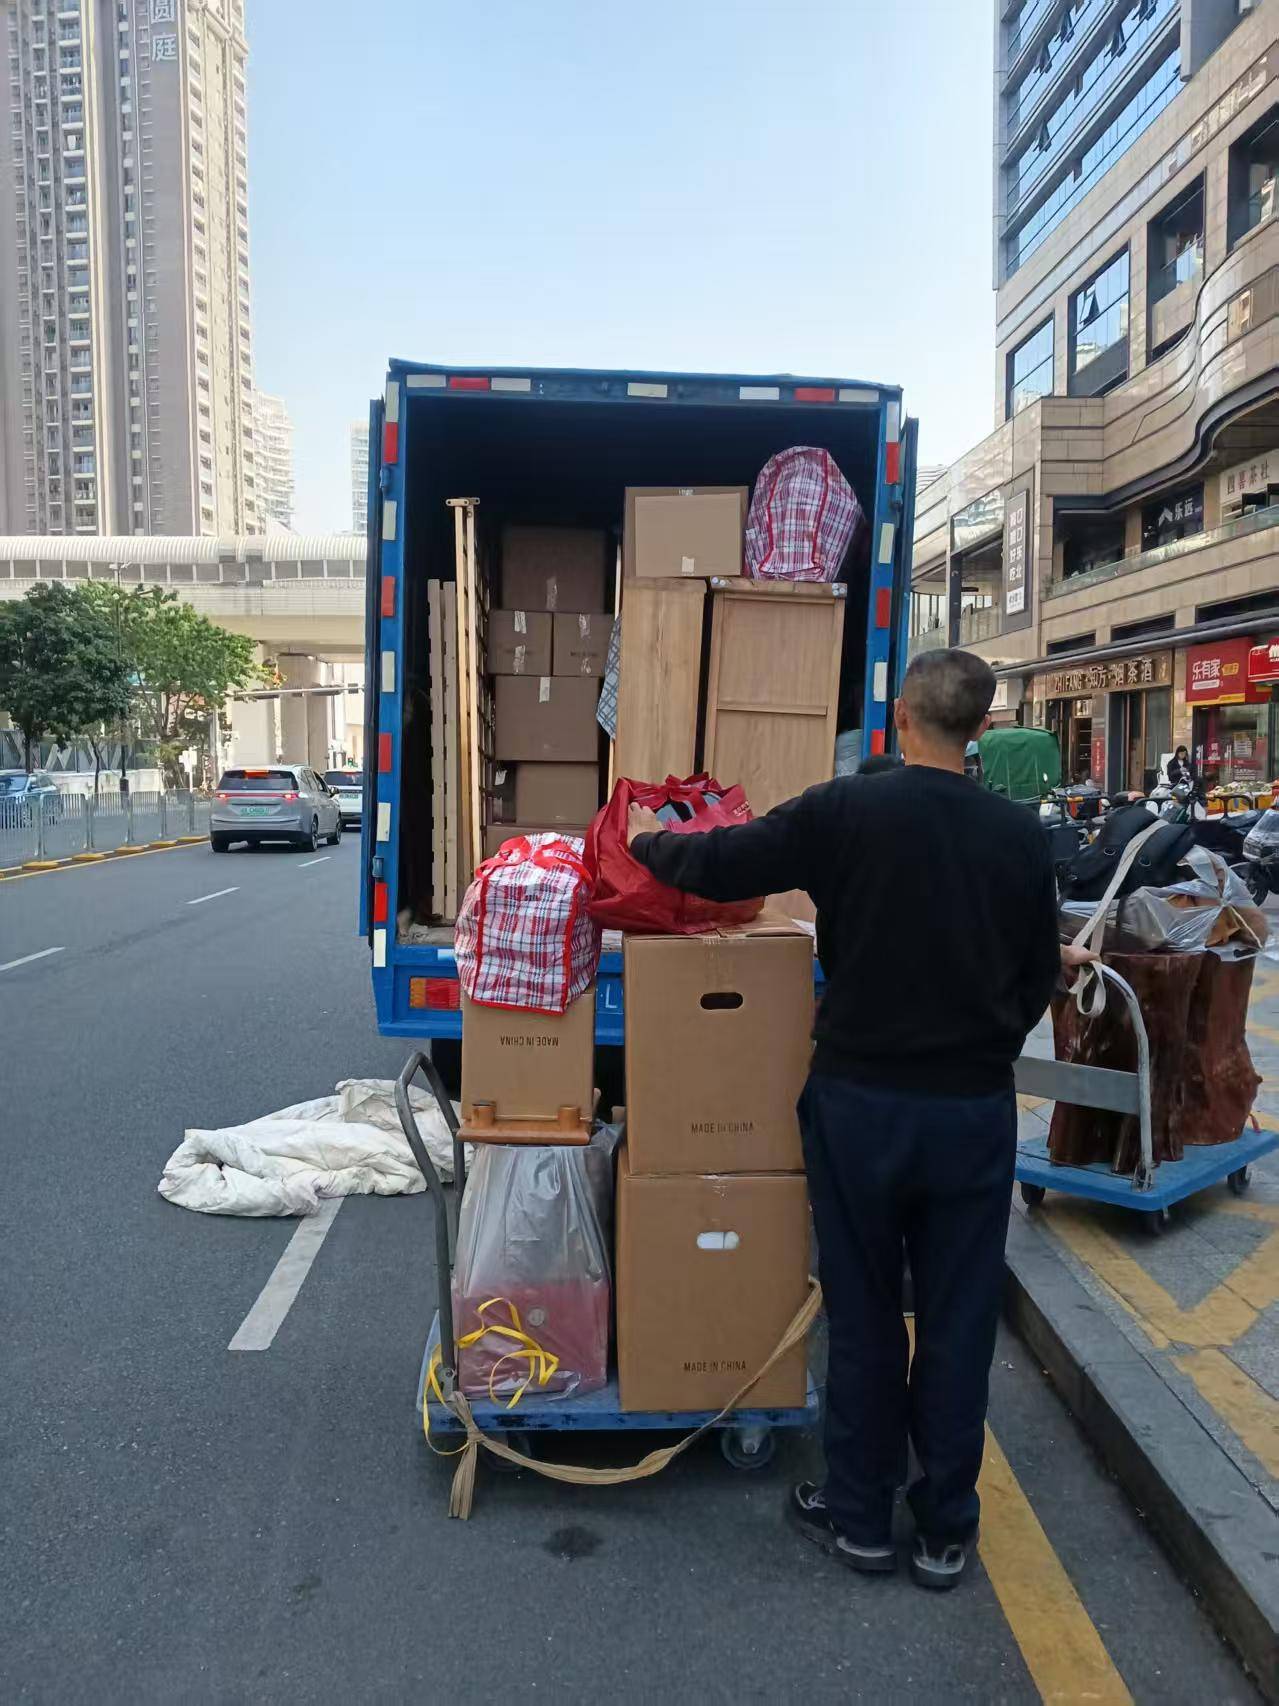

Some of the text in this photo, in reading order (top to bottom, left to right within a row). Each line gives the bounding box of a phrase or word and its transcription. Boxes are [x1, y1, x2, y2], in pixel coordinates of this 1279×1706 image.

[1192, 658, 1221, 681] 乐有家
[500, 1035, 559, 1047] MADE IN CHINA
[691, 1122, 715, 1134] MADE
[728, 1121, 754, 1133] CHINA
[683, 1362, 707, 1373] MADE
[720, 1360, 746, 1371] CHINA
